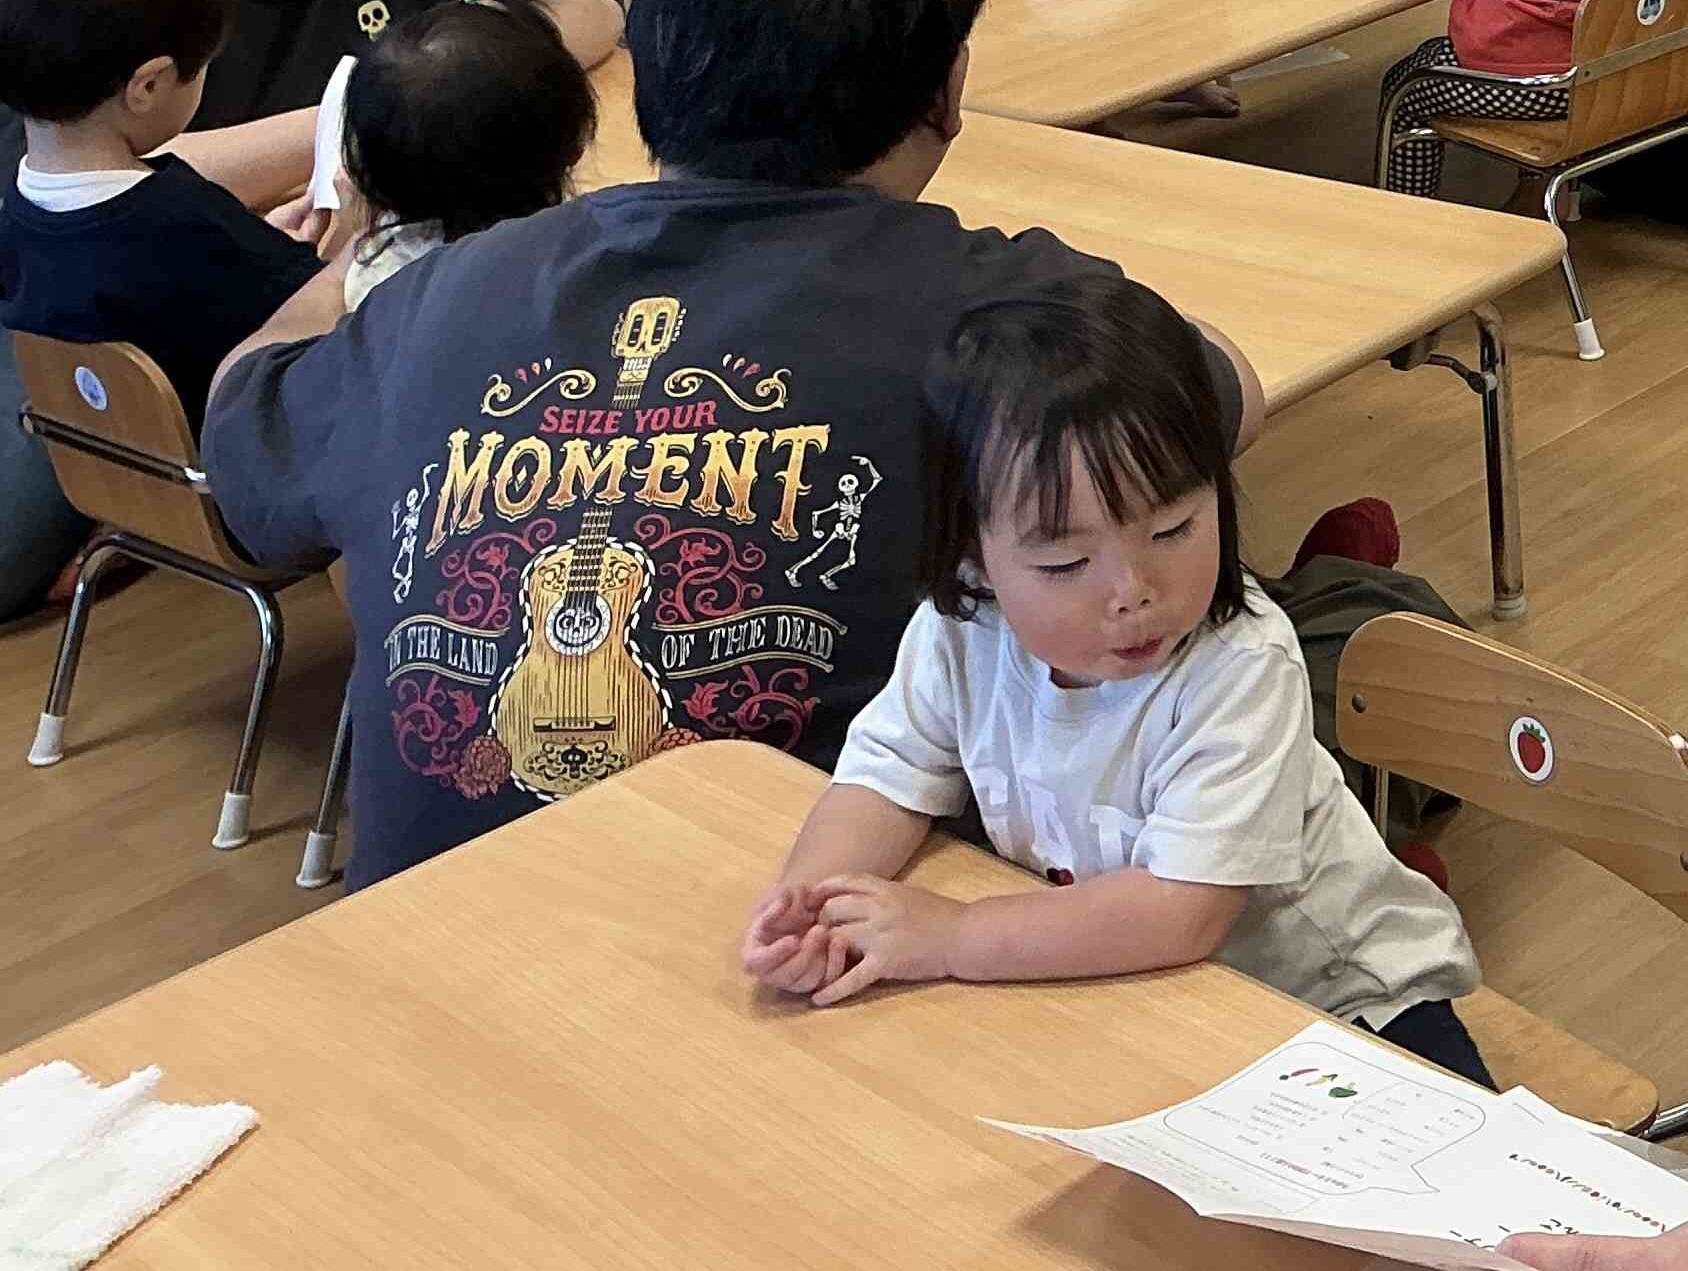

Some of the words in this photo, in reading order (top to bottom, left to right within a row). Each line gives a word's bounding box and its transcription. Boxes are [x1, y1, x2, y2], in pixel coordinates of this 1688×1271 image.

[539, 404, 622, 435] SEIZE
[634, 400, 719, 434] YOUR
[424, 423, 831, 559] MOMENT
[407, 625, 441, 660] THE
[447, 632, 498, 676] LAND
[661, 633, 696, 669] OF
[708, 616, 767, 661] THE
[775, 615, 834, 660] DEAD
